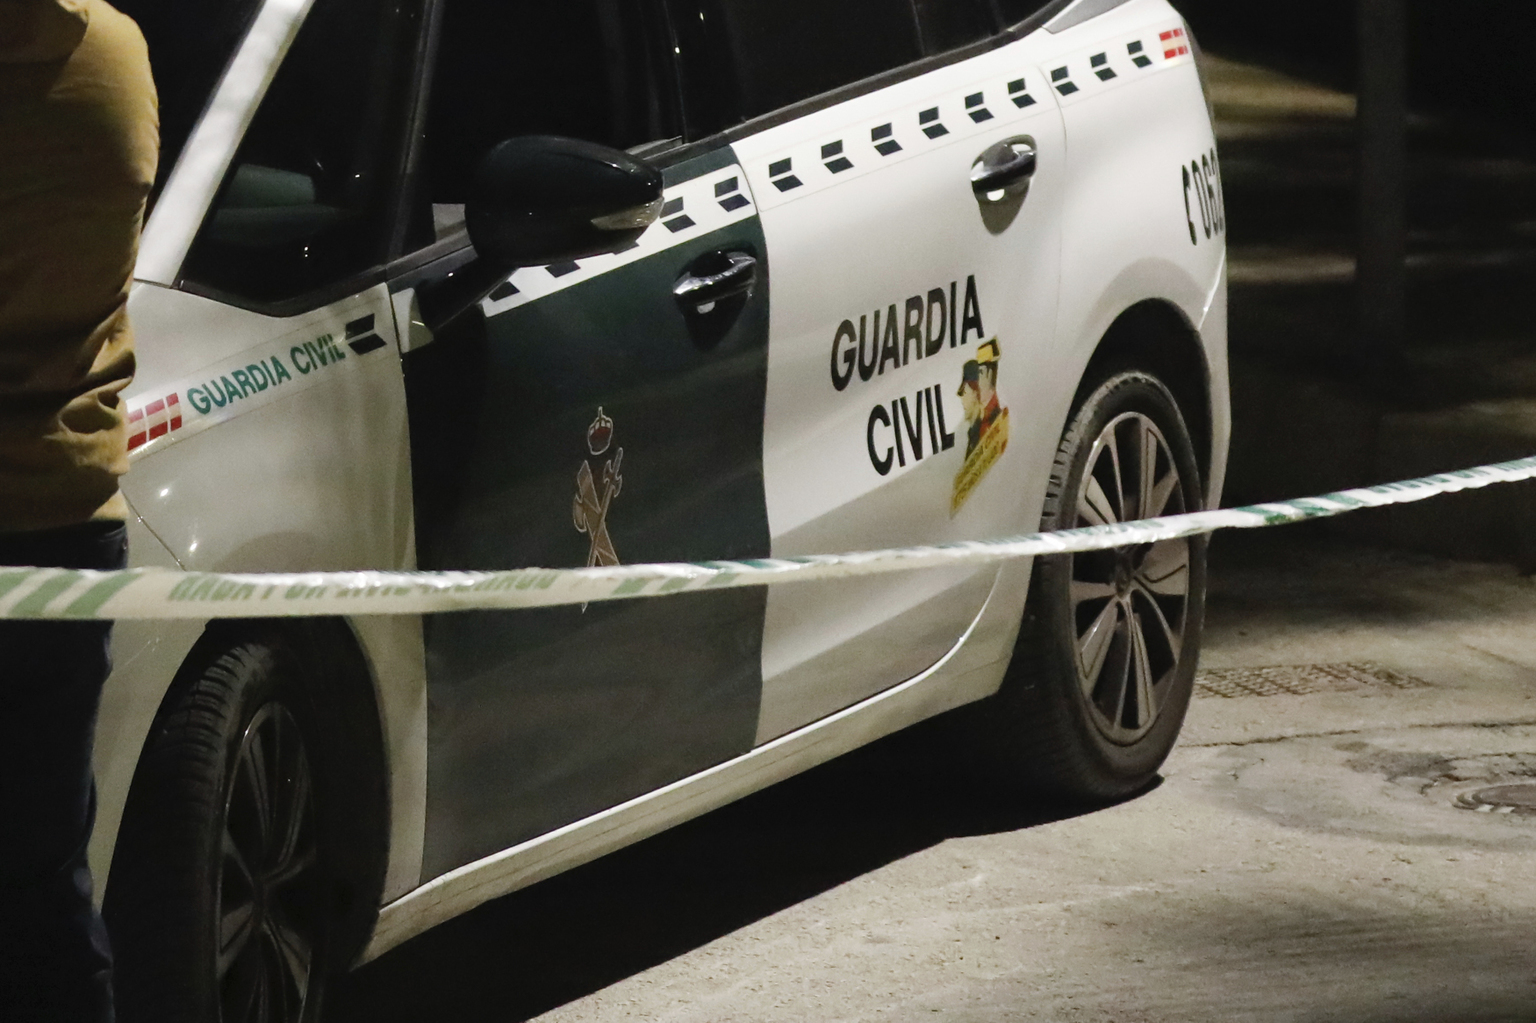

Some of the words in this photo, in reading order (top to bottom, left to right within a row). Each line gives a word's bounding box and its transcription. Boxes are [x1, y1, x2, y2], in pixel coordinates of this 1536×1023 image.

[186, 355, 292, 416] GUARDIA
[289, 333, 346, 375] CIVIL
[830, 274, 986, 392] GUARDIA
[867, 383, 956, 476] CIVIL
